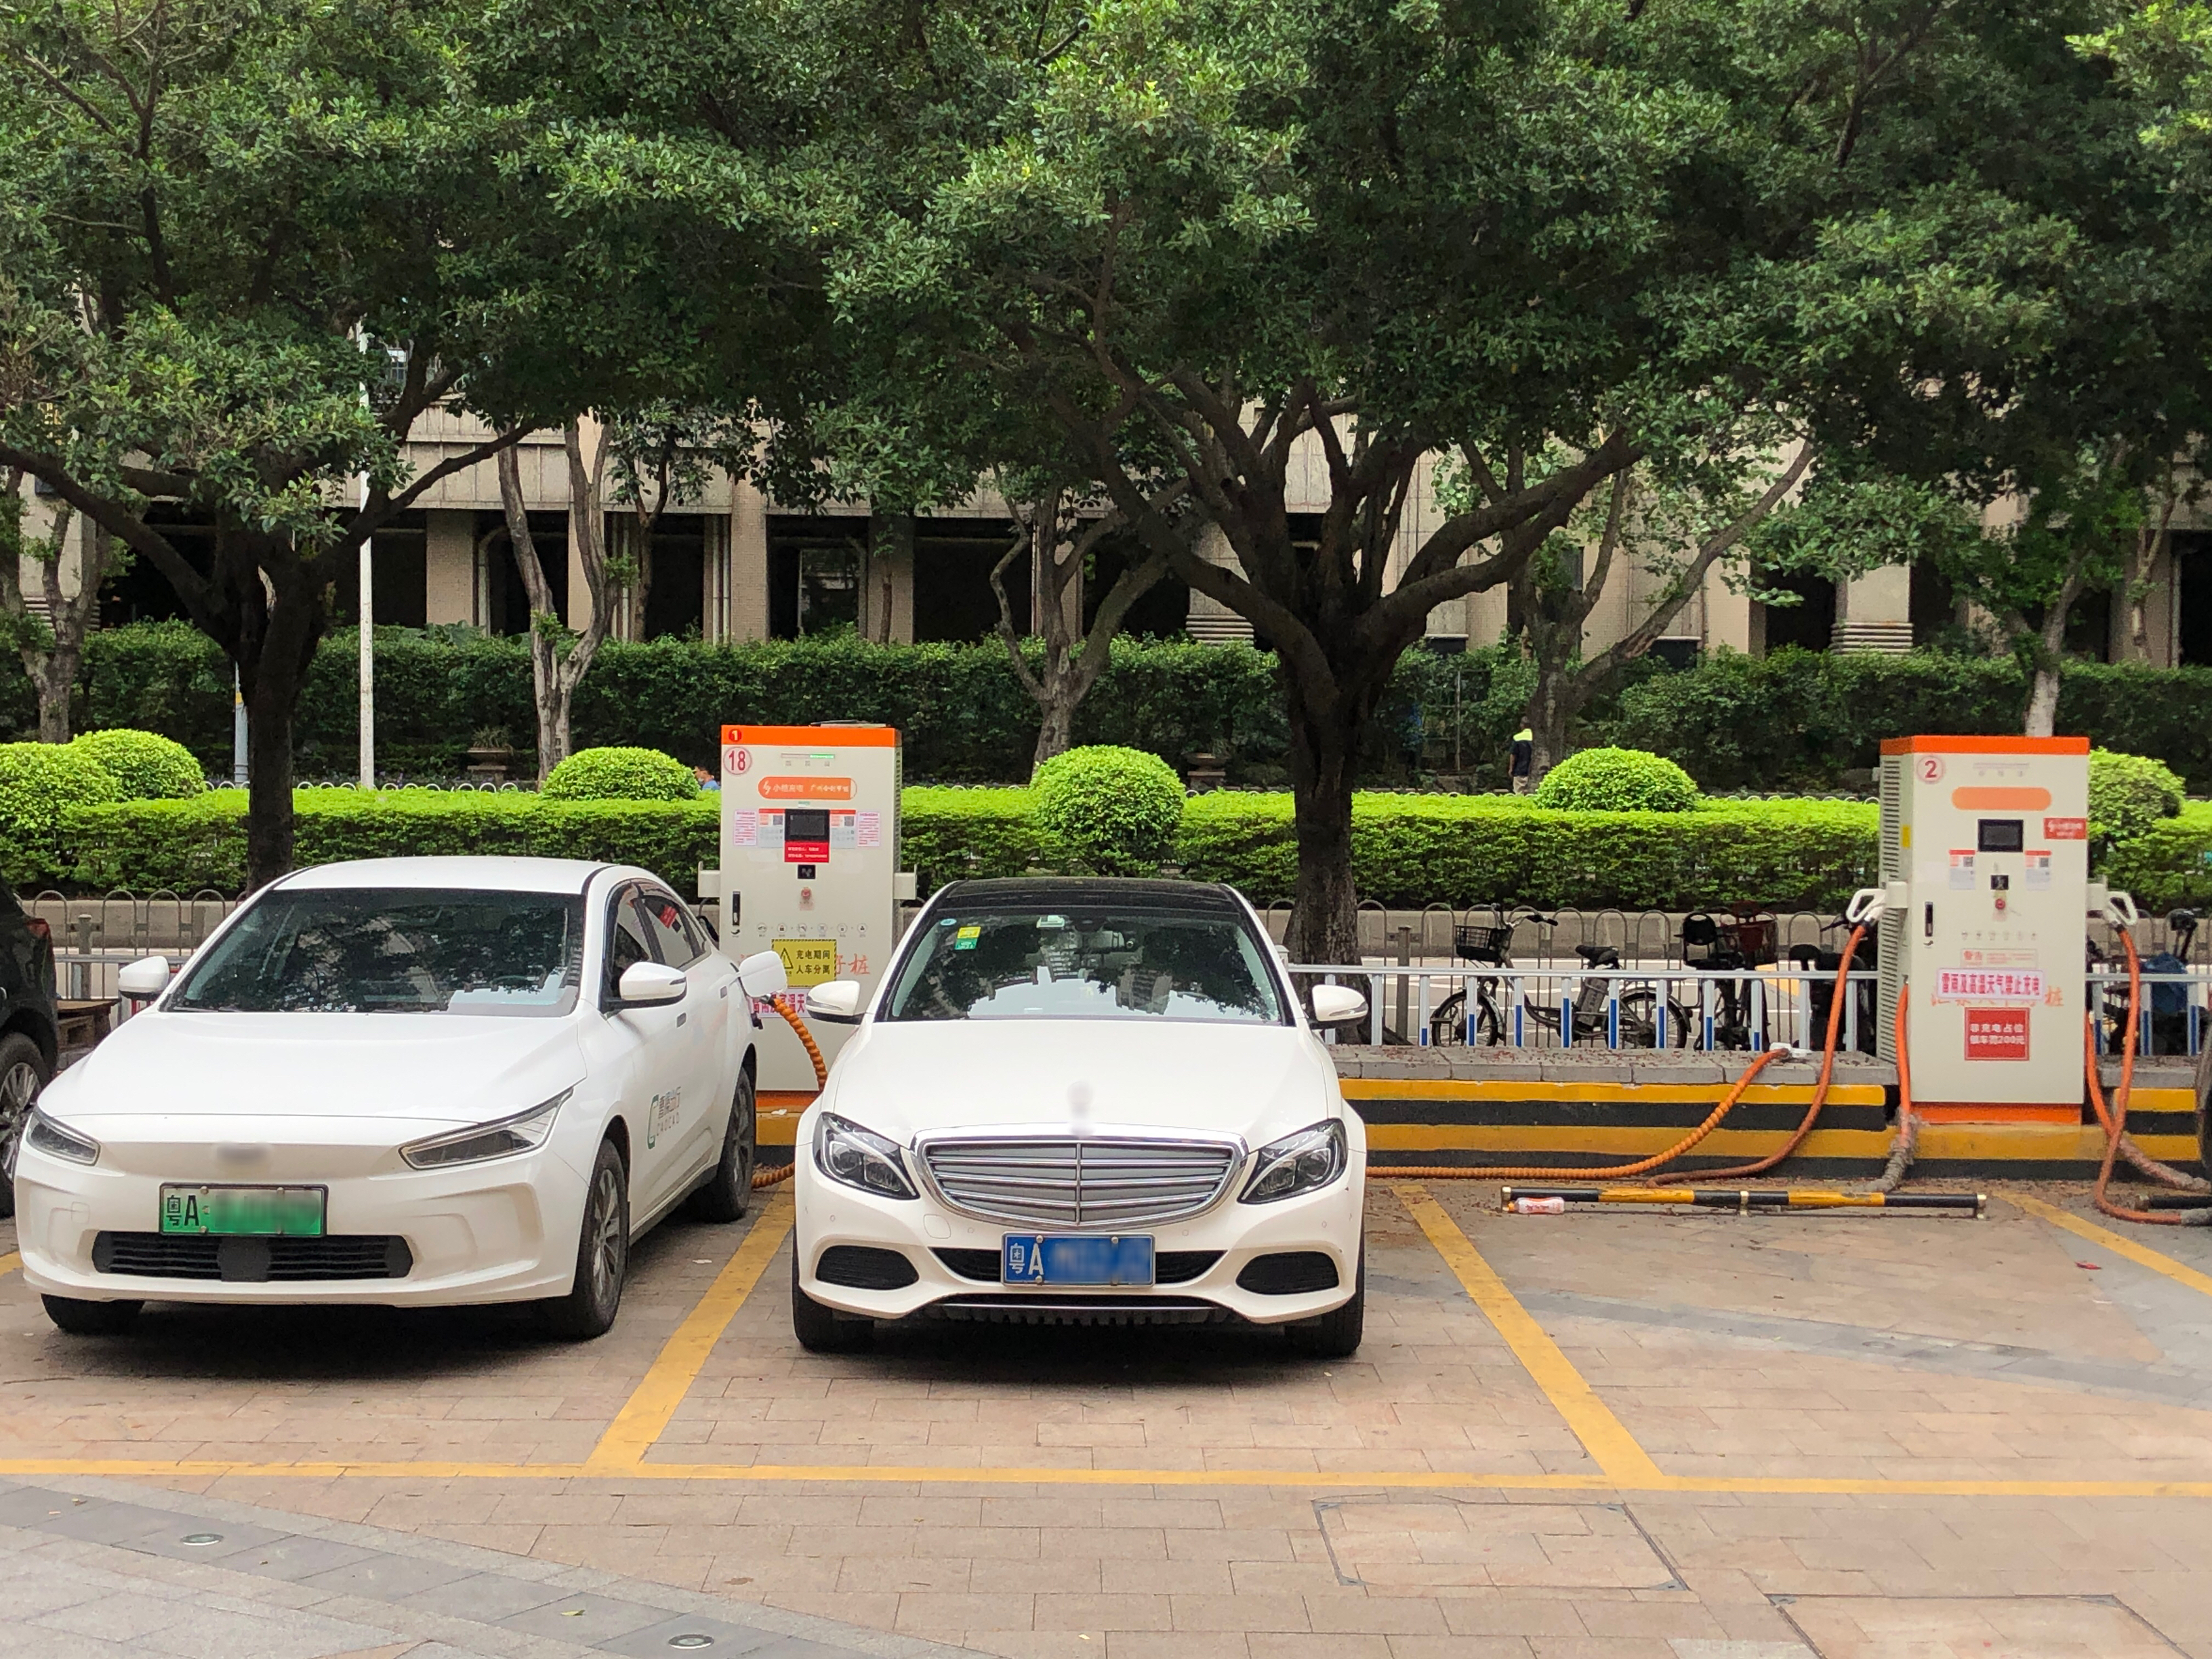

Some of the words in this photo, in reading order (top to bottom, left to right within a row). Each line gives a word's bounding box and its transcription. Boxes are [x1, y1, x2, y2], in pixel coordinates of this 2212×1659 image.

[729, 750, 746, 771] 18
[1925, 760, 1938, 779] 2
[796, 949, 831, 960] 充电期间
[796, 964, 831, 975] 人车分离
[1942, 972, 2041, 996] 雷雨及高温天气禁止充电
